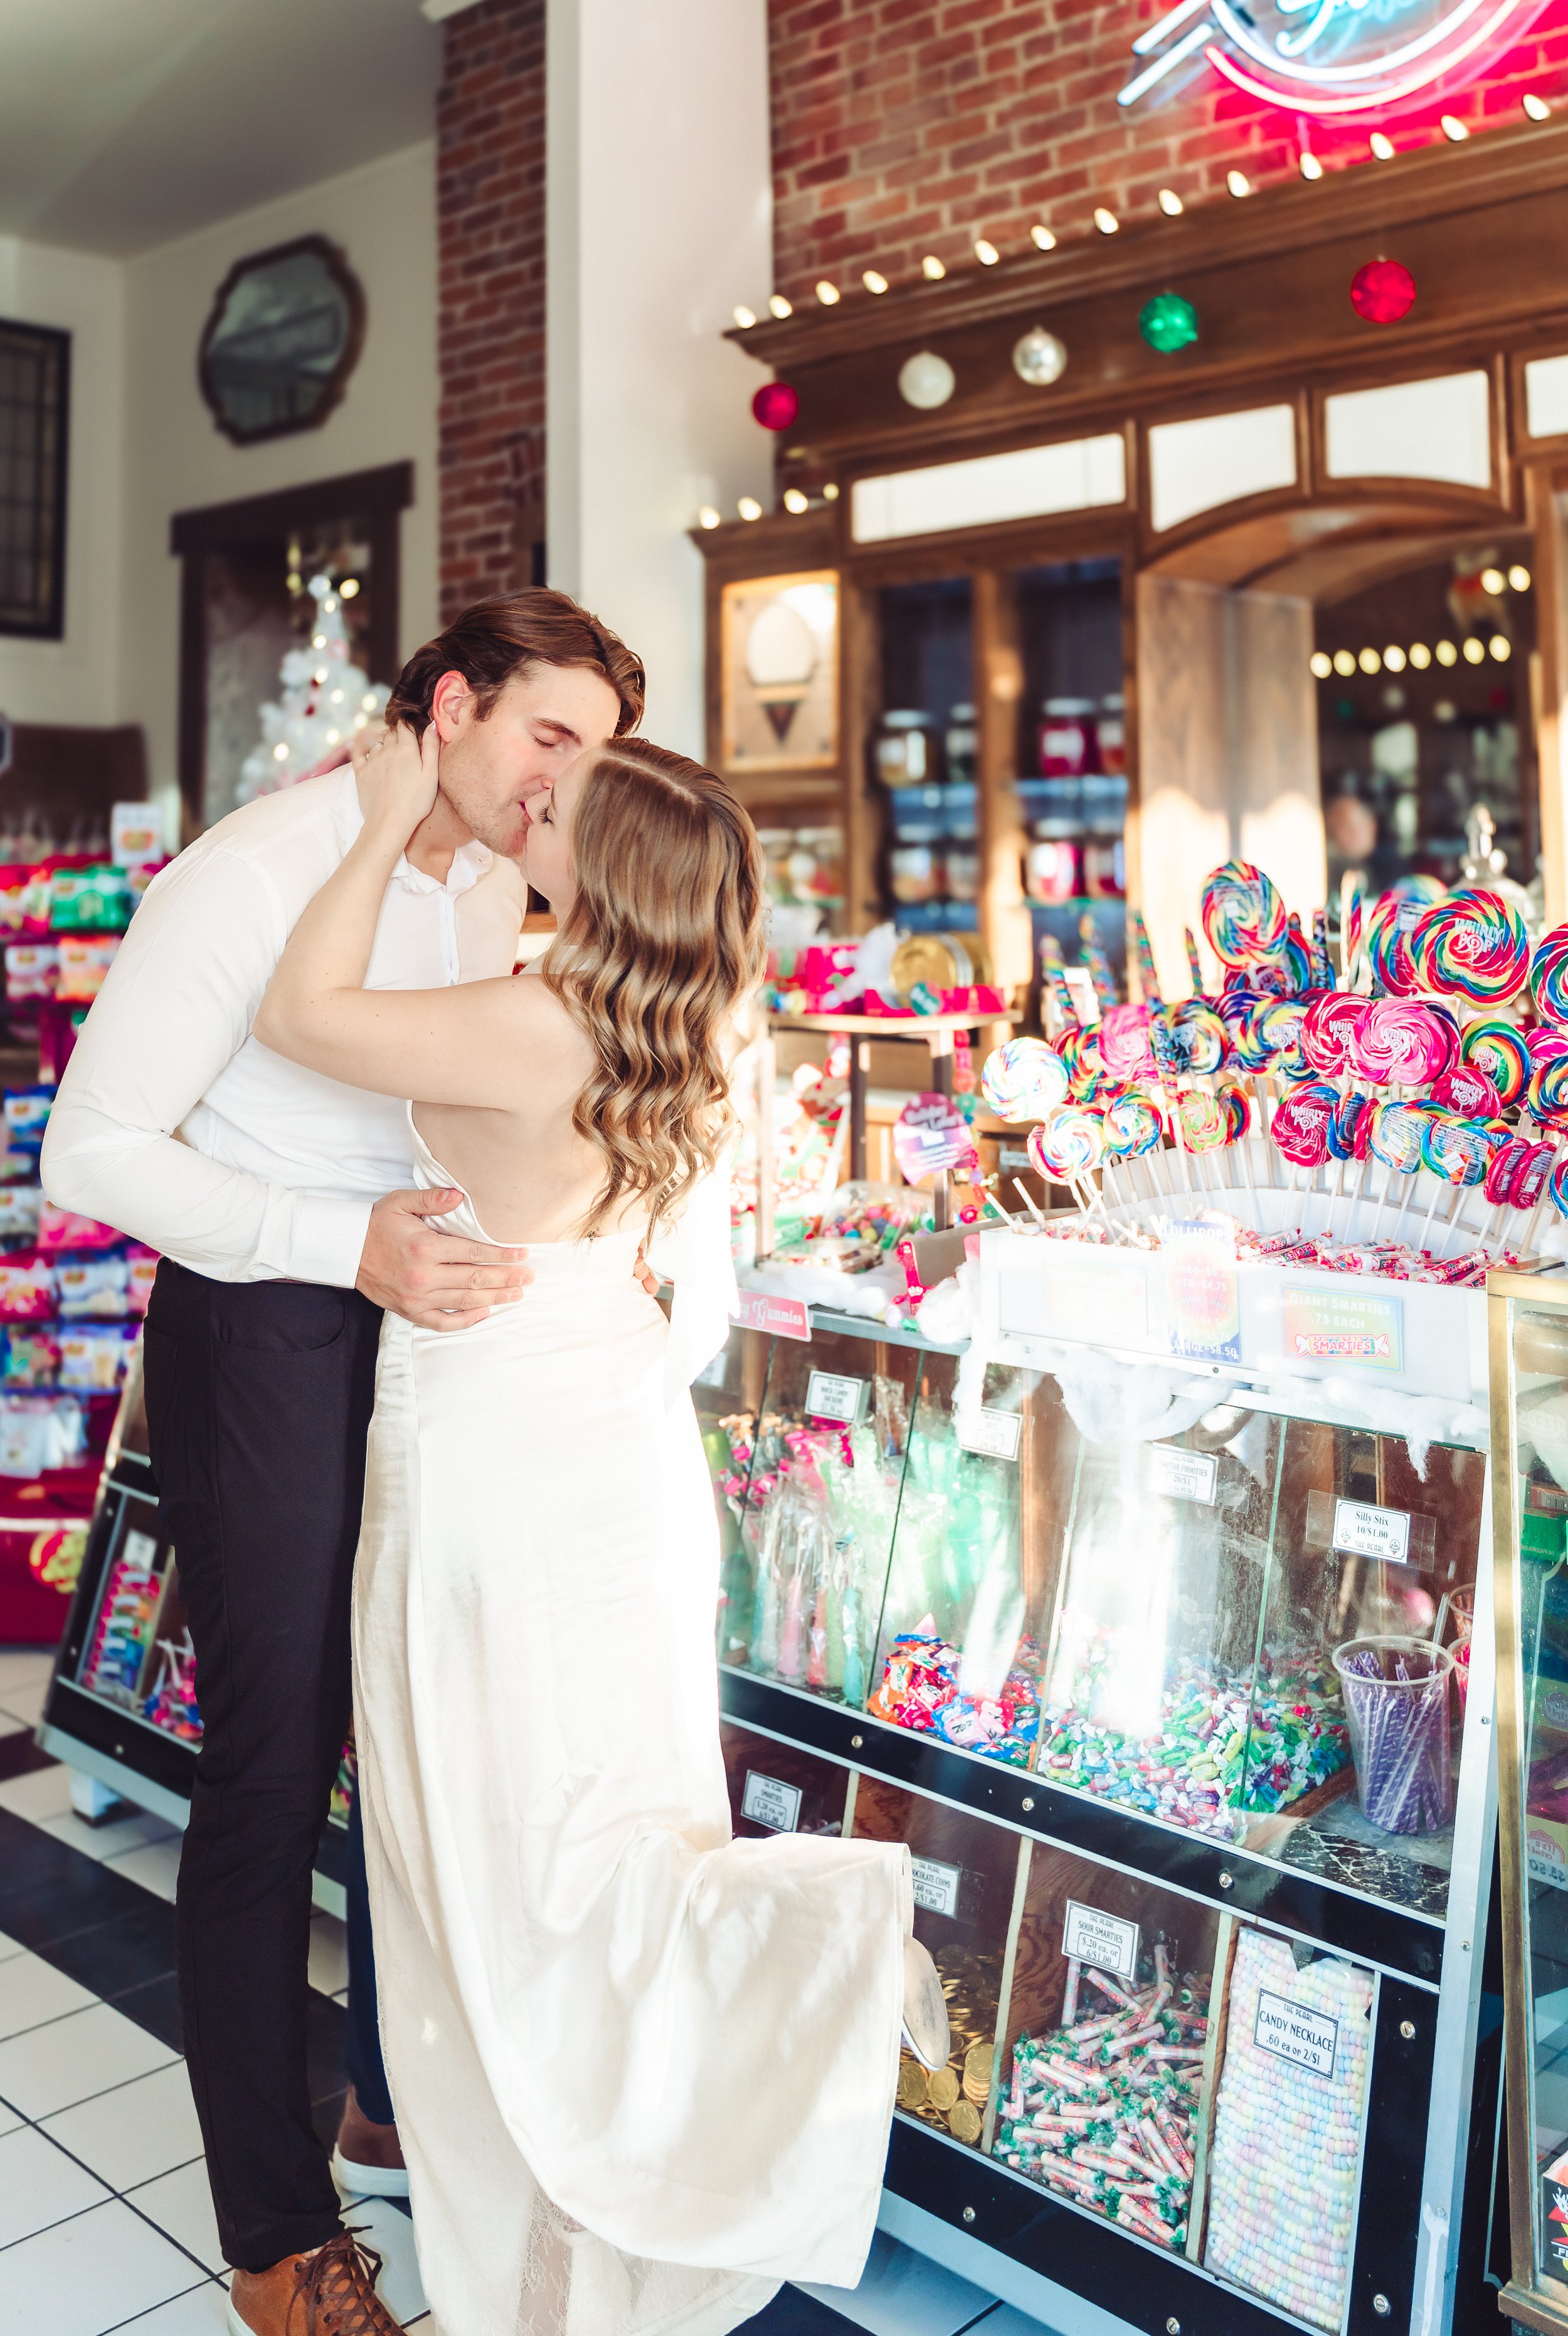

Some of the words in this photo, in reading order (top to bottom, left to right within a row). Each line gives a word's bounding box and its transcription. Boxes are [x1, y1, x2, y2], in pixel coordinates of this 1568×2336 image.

[1454, 917, 1504, 944] WHIRLY
[1458, 932, 1494, 955] POP
[1472, 1044, 1504, 1068] WHIRLY
[1450, 1077, 1486, 1102] WHIRLY
[1452, 1090, 1478, 1107] POP
[1290, 1105, 1326, 1122] WHIRLY
[1293, 1116, 1319, 1130] POP
[753, 1298, 803, 1326] Gummies
[1290, 1292, 1328, 1307] GIANT
[1332, 1297, 1391, 1316] SMARTIES
[1333, 1315, 1365, 1329] EACH
[1313, 1340, 1372, 1351] SMARTIES
[1181, 1465, 1208, 1477] FROOTIES
[1355, 1510, 1372, 1524] Silly
[1374, 1514, 1389, 1526] Stix
[1357, 1526, 1389, 1539] 10/$1.00
[1355, 1541, 1365, 1549] THE
[1367, 1543, 1385, 1553] PEARL
[935, 1876, 951, 1889] COINS
[1089, 1914, 1098, 1923] THE
[1099, 1918, 1115, 1929] PEARL
[1078, 1920, 1094, 1934] SOUR
[1095, 1926, 1123, 1944] SMARTIES
[1081, 1936, 1097, 1949] $.20
[1098, 1945, 1109, 1954] ea.
[1086, 1949, 1112, 1965] 6/$1.00
[1283, 2003, 1294, 2015] THE
[1295, 2008, 1313, 2023] PEARL
[1259, 2010, 1289, 2032] CANDY
[1290, 2023, 1333, 2052] NECKLACE
[1266, 2034, 1279, 2047] .60
[1281, 2042, 1290, 2052] ea
[1292, 2047, 1301, 2056] or
